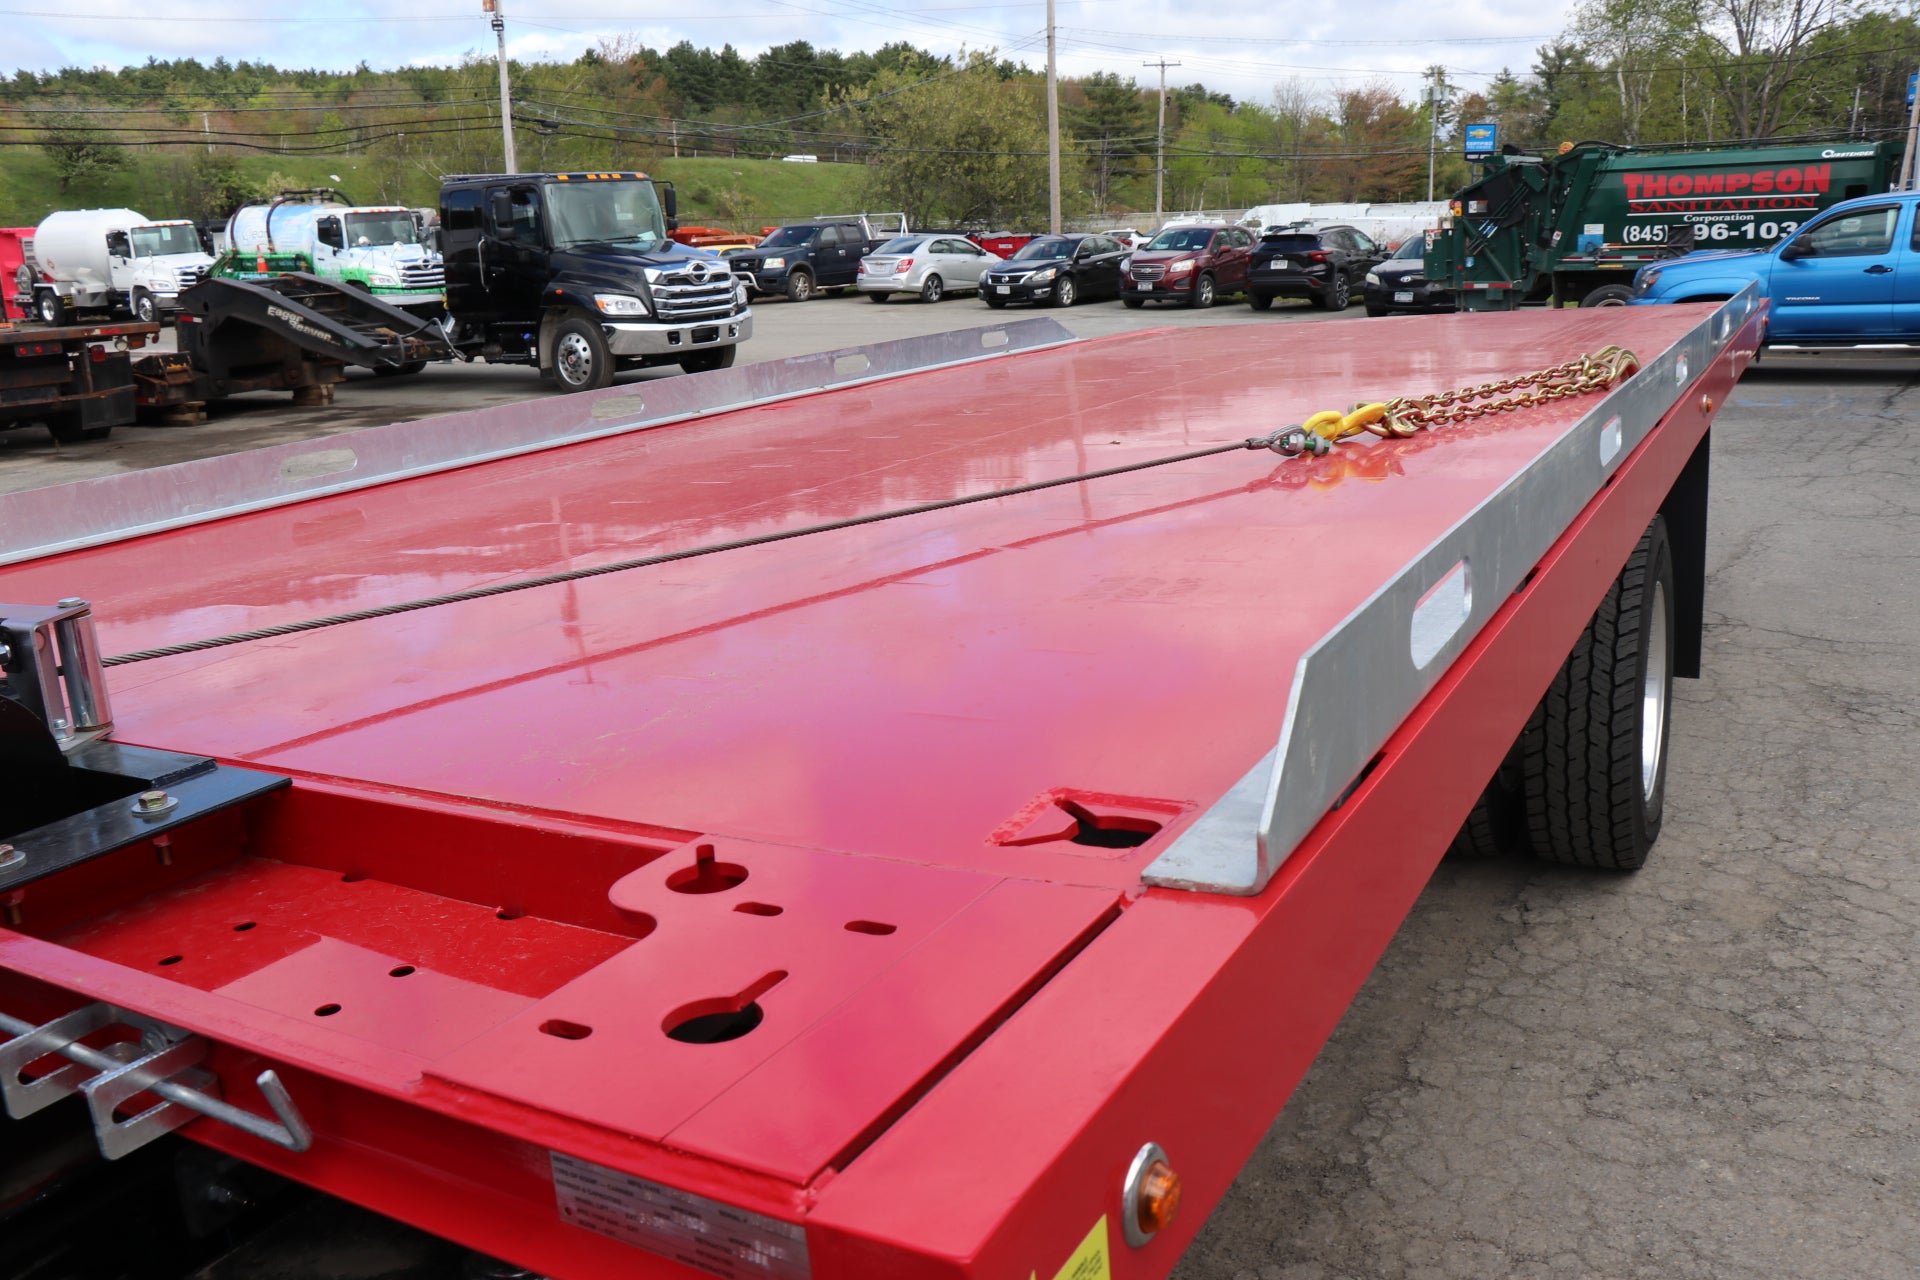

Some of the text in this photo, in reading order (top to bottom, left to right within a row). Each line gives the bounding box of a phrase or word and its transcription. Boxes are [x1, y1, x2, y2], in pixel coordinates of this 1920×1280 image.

[1622, 164, 1832, 199] THOMPSON
[1630, 196, 1817, 213] SANITATION
[1683, 213, 1755, 224] Corporation
[1622, 225, 1668, 244] (845)
[1672, 221, 1806, 241] 96-103
[267, 305, 304, 321] Eager
